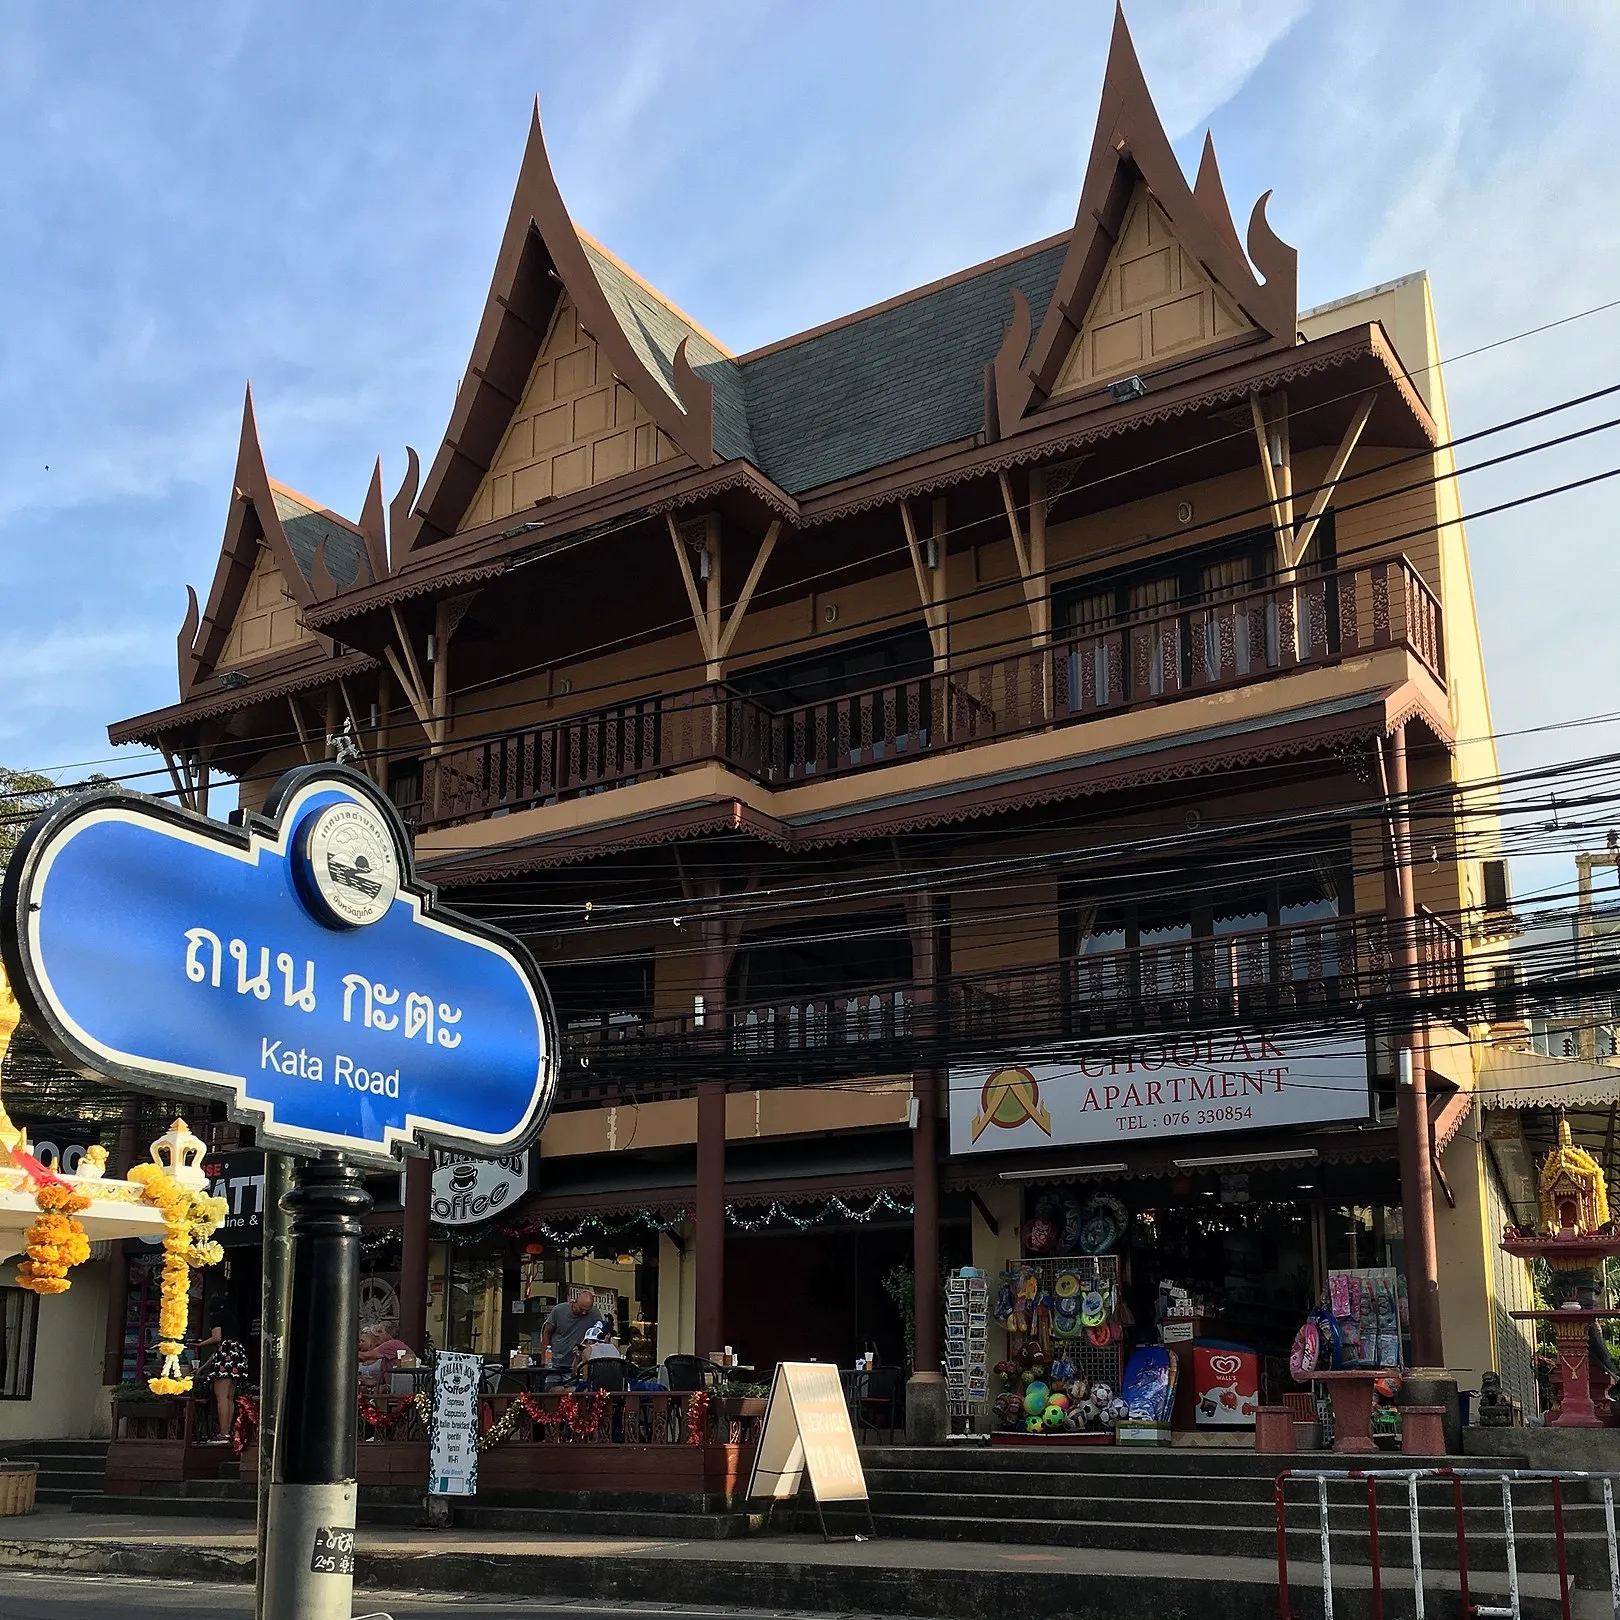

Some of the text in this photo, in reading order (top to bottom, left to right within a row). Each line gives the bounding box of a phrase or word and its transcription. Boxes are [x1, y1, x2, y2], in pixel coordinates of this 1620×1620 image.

[183, 927, 463, 1049] ถนน กะตะ
[261, 1037, 400, 1099] Kata Road
[1080, 1066, 1290, 1113] APARTMENT
[1116, 1113, 1148, 1131] TEL
[1163, 1111, 1190, 1127] 076
[1197, 1105, 1253, 1125] 330854
[431, 1181, 510, 1220] offee
[249, 1214, 259, 1226] &
[440, 1363, 475, 1381] ITALIAN JOB
[443, 1380, 471, 1395] Coffee
